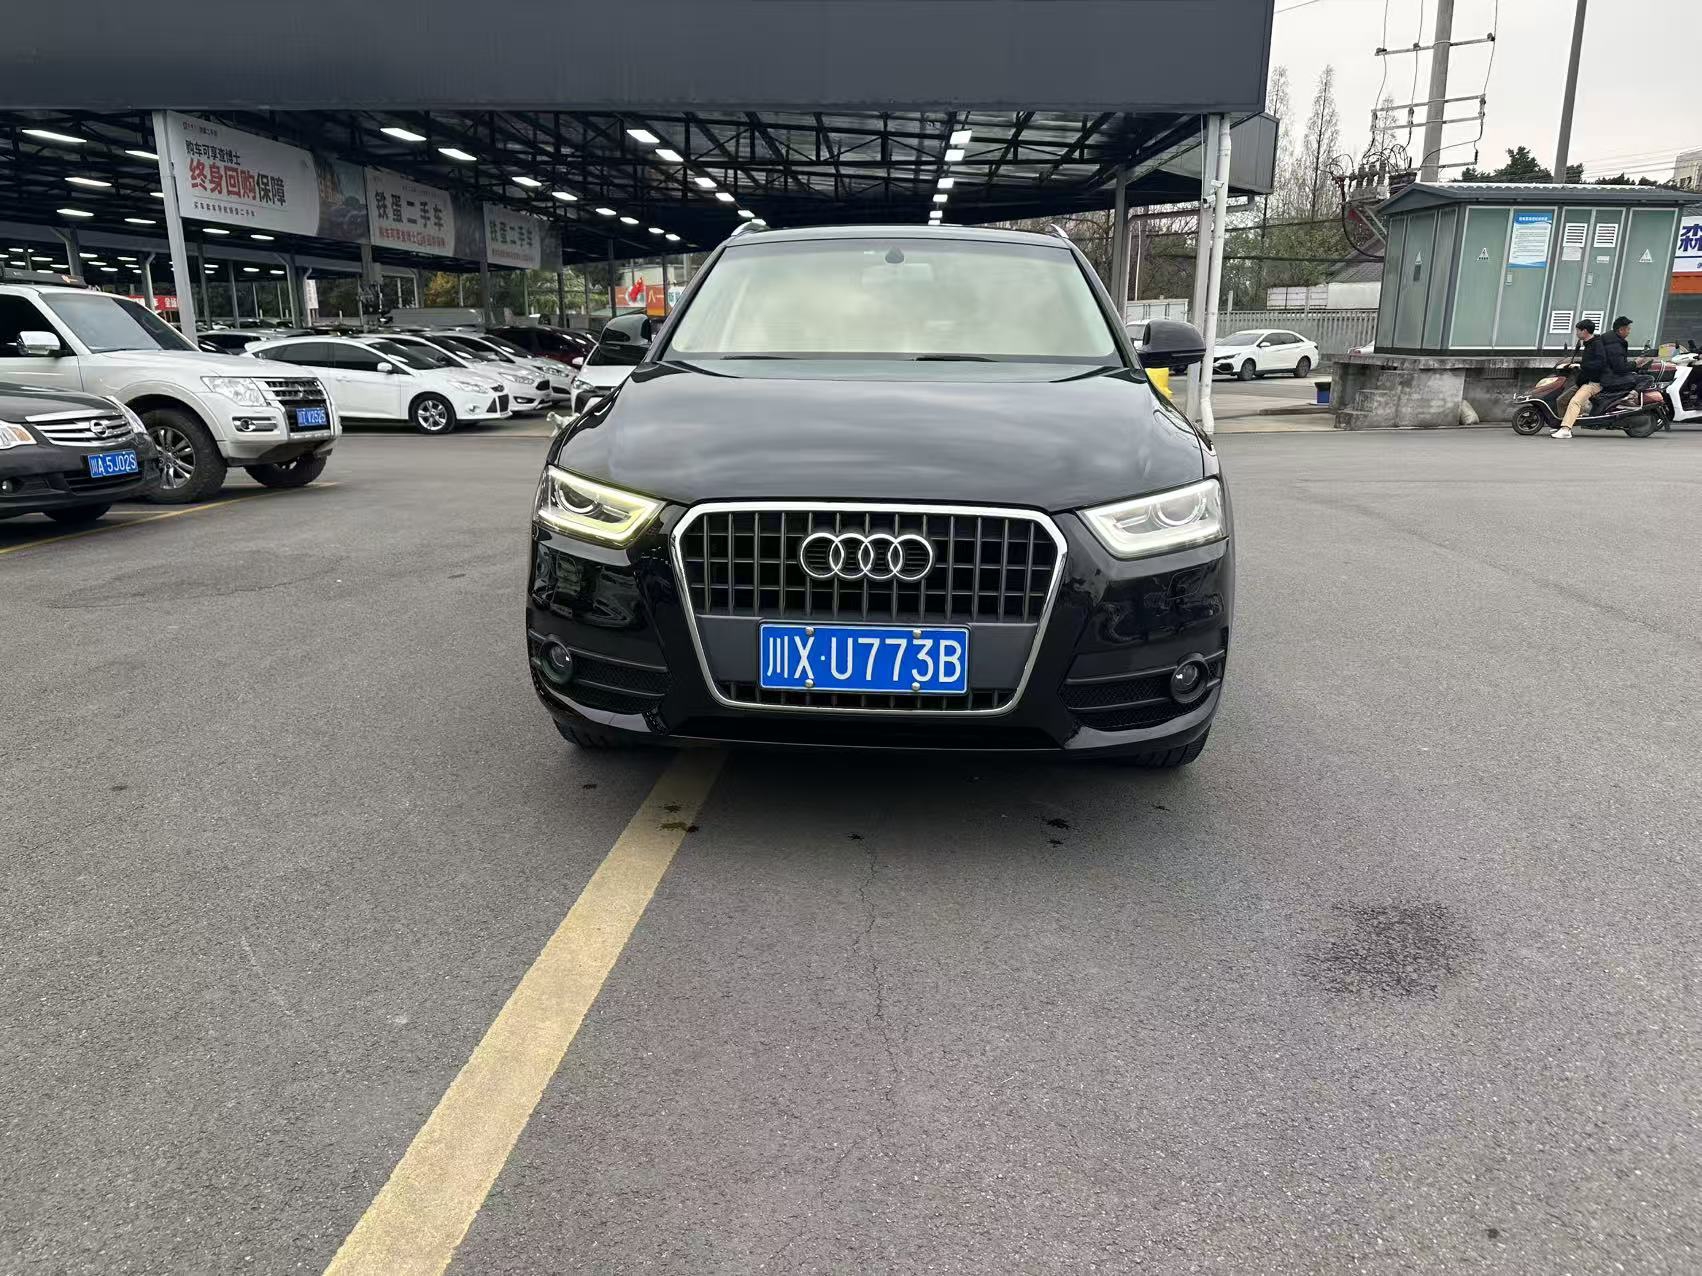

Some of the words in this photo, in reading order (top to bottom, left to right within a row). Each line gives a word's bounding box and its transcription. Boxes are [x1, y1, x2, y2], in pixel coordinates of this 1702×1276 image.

[185, 139, 241, 166] 购车可享查博士
[189, 159, 287, 206] 终身回购保障
[374, 190, 444, 231] 铁蛋二手车
[489, 221, 533, 248] 铁蛋二手车
